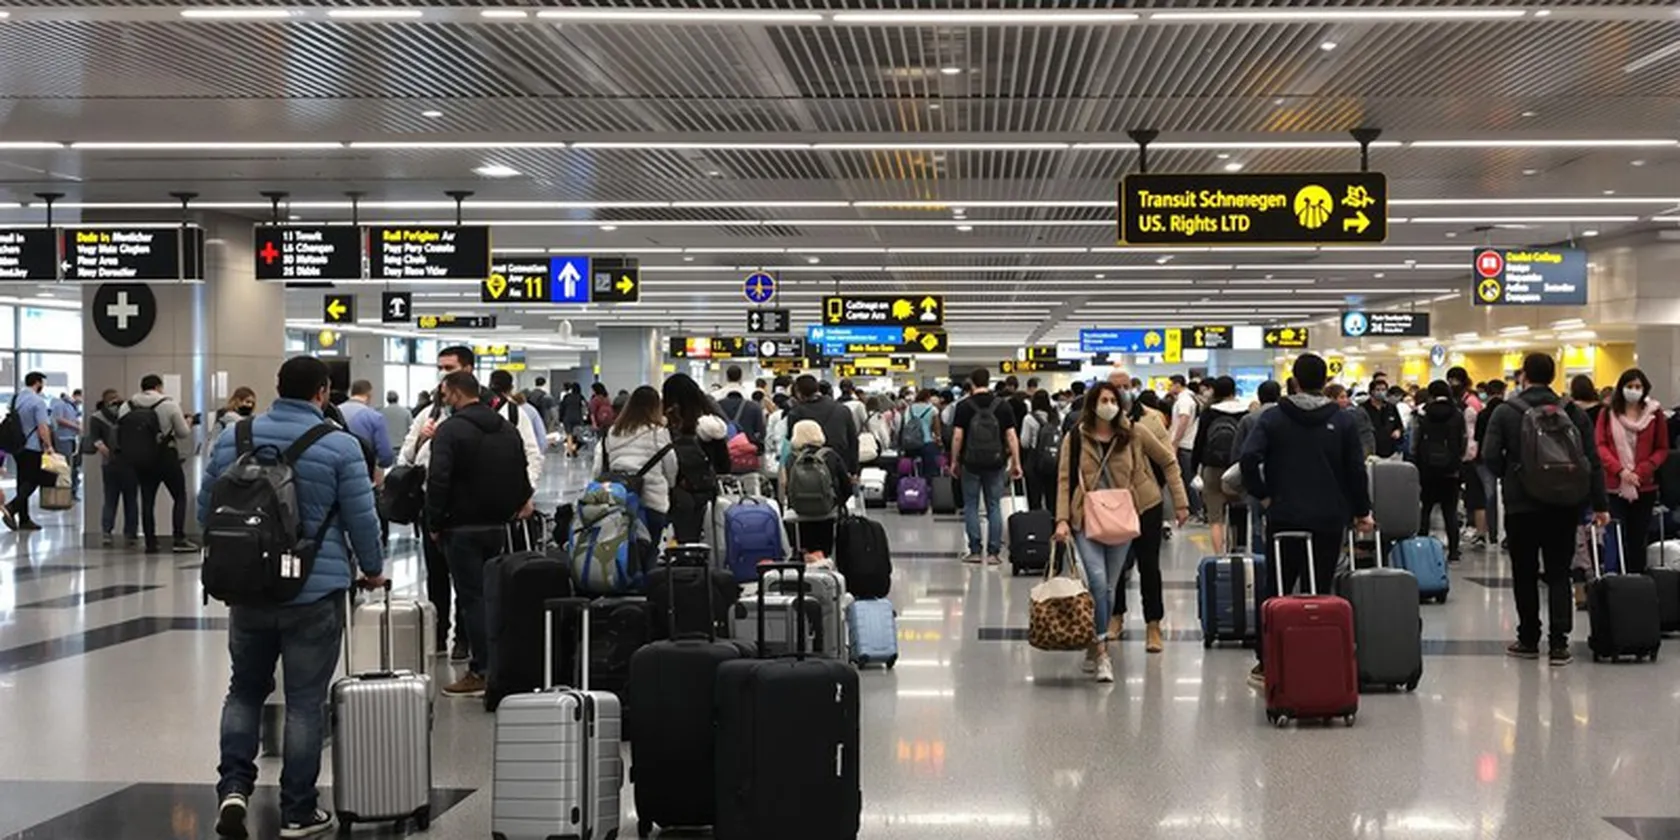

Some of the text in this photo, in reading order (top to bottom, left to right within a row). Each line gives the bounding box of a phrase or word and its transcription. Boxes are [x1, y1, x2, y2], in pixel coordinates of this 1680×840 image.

[1170, 213, 1218, 236] Rights
[1221, 214, 1251, 232] LTD
[524, 276, 543, 299] 11
